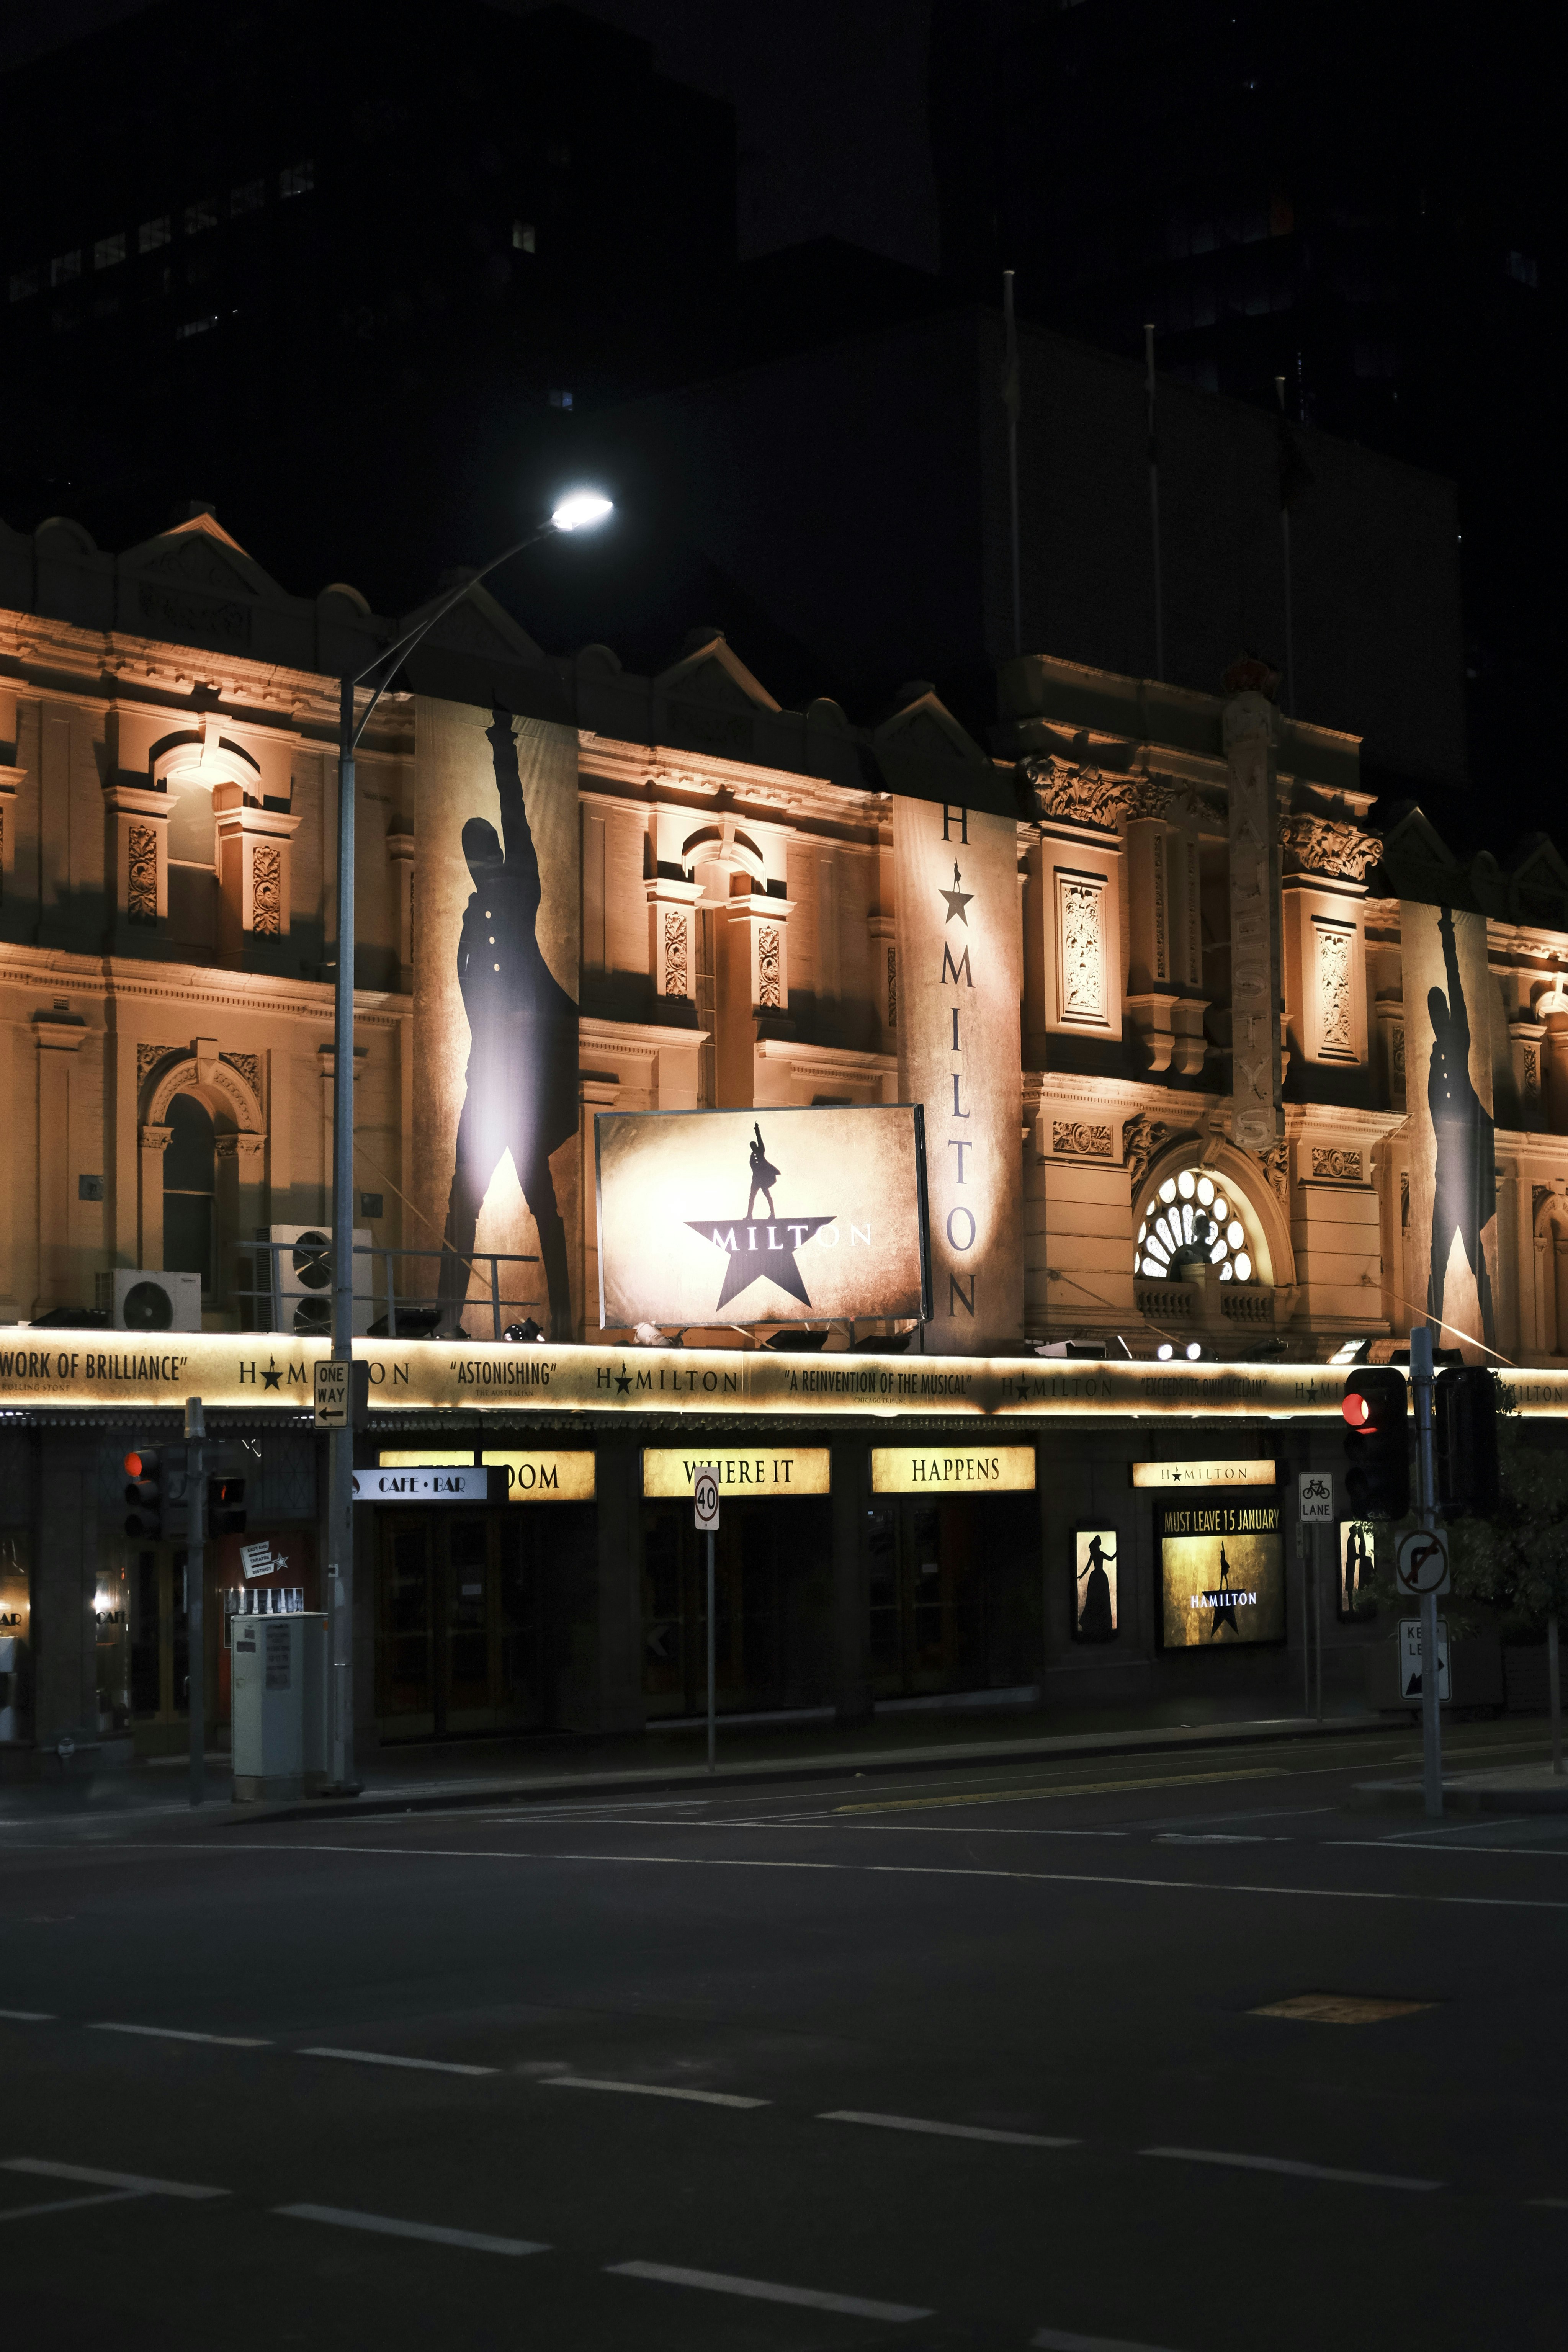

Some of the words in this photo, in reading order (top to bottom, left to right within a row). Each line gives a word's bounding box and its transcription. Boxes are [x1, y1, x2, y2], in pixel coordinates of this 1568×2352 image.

[0, 1351, 51, 1377] WORK
[58, 1353, 79, 1378] OF
[86, 1353, 187, 1381] BRILLIANCE"
[320, 1367, 344, 1382] ONE
[450, 1361, 557, 1385] "ASTONISHING"
[784, 1370, 798, 1391] "A
[802, 1370, 875, 1393] REINVENTION
[881, 1373, 894, 1393] OF
[898, 1373, 917, 1394] THE
[921, 1375, 972, 1394] MUSICAL"
[1141, 1377, 1183, 1396] "EXCEEDS
[1187, 1378, 1199, 1396] ITS
[1203, 1378, 1223, 1397] OWN
[1226, 1379, 1267, 1397] ACCLAIM"
[318, 1388, 345, 1402] WAY
[773, 1460, 794, 1483] IT
[912, 1458, 999, 1481] HAPPENS
[379, 1477, 419, 1492] CAFE
[433, 1476, 465, 1492] BAR
[697, 1487, 715, 1510] 40
[1303, 1504, 1330, 1515] LANE
[1165, 1511, 1190, 1533] MUST
[1194, 1510, 1220, 1531] LEAVE
[1224, 1510, 1235, 1530] 15
[1238, 1509, 1279, 1530] JANUARY
[1190, 1592, 1256, 1608] HAMILTON
